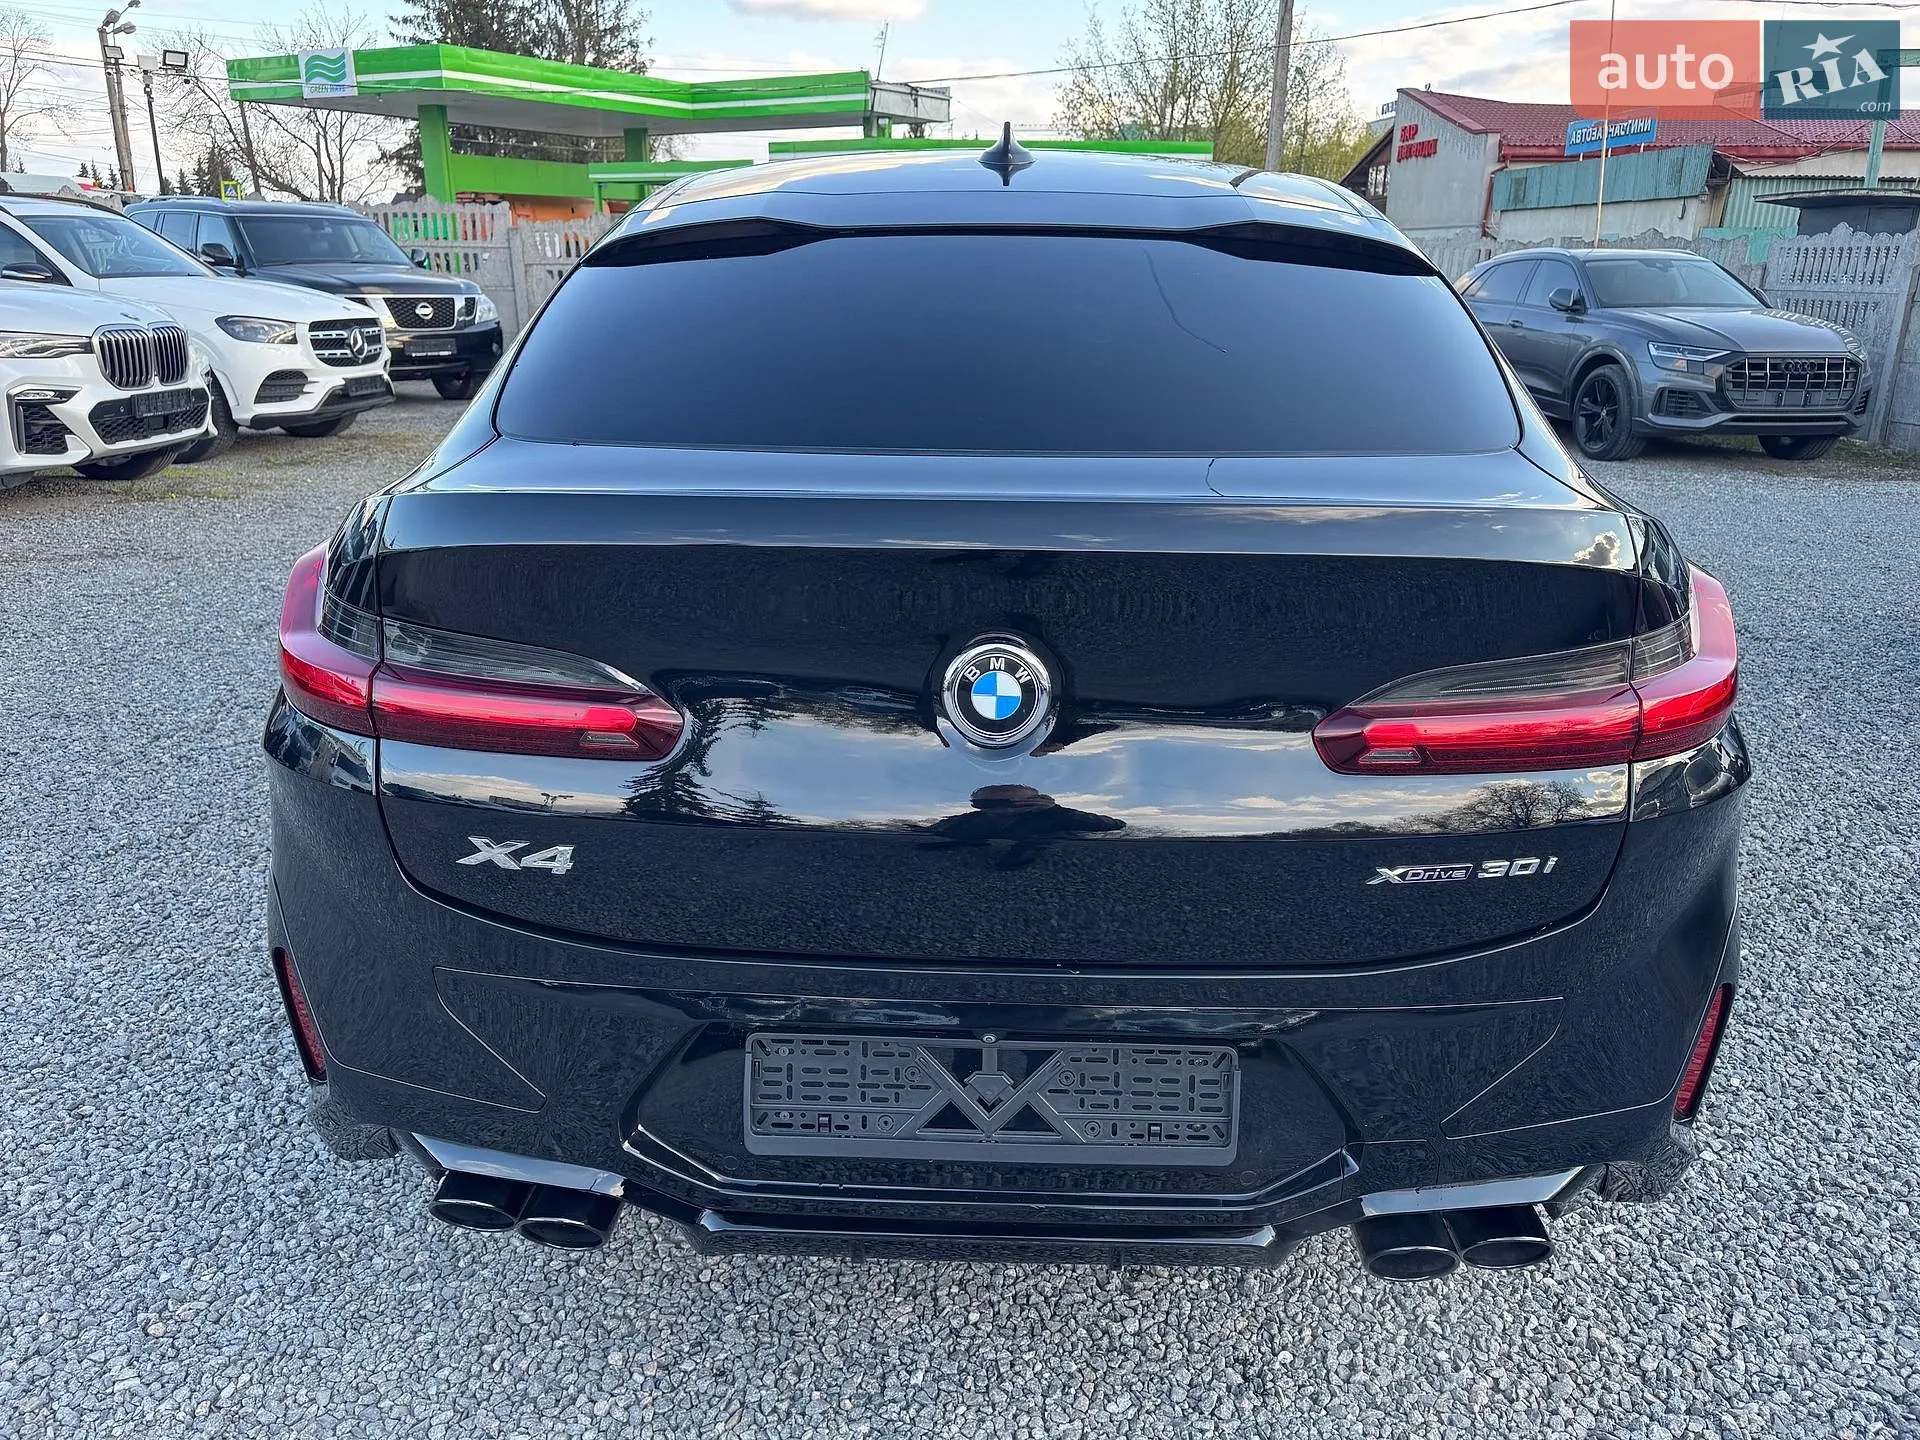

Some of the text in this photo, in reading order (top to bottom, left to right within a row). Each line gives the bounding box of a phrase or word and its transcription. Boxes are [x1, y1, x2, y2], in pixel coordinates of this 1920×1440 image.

[1400, 124, 1418, 143] БАР
[1569, 115, 1653, 146] АВТОЗАЧАСТИНИ
[963, 657, 1032, 684] BMW
[455, 835, 575, 875] X4
